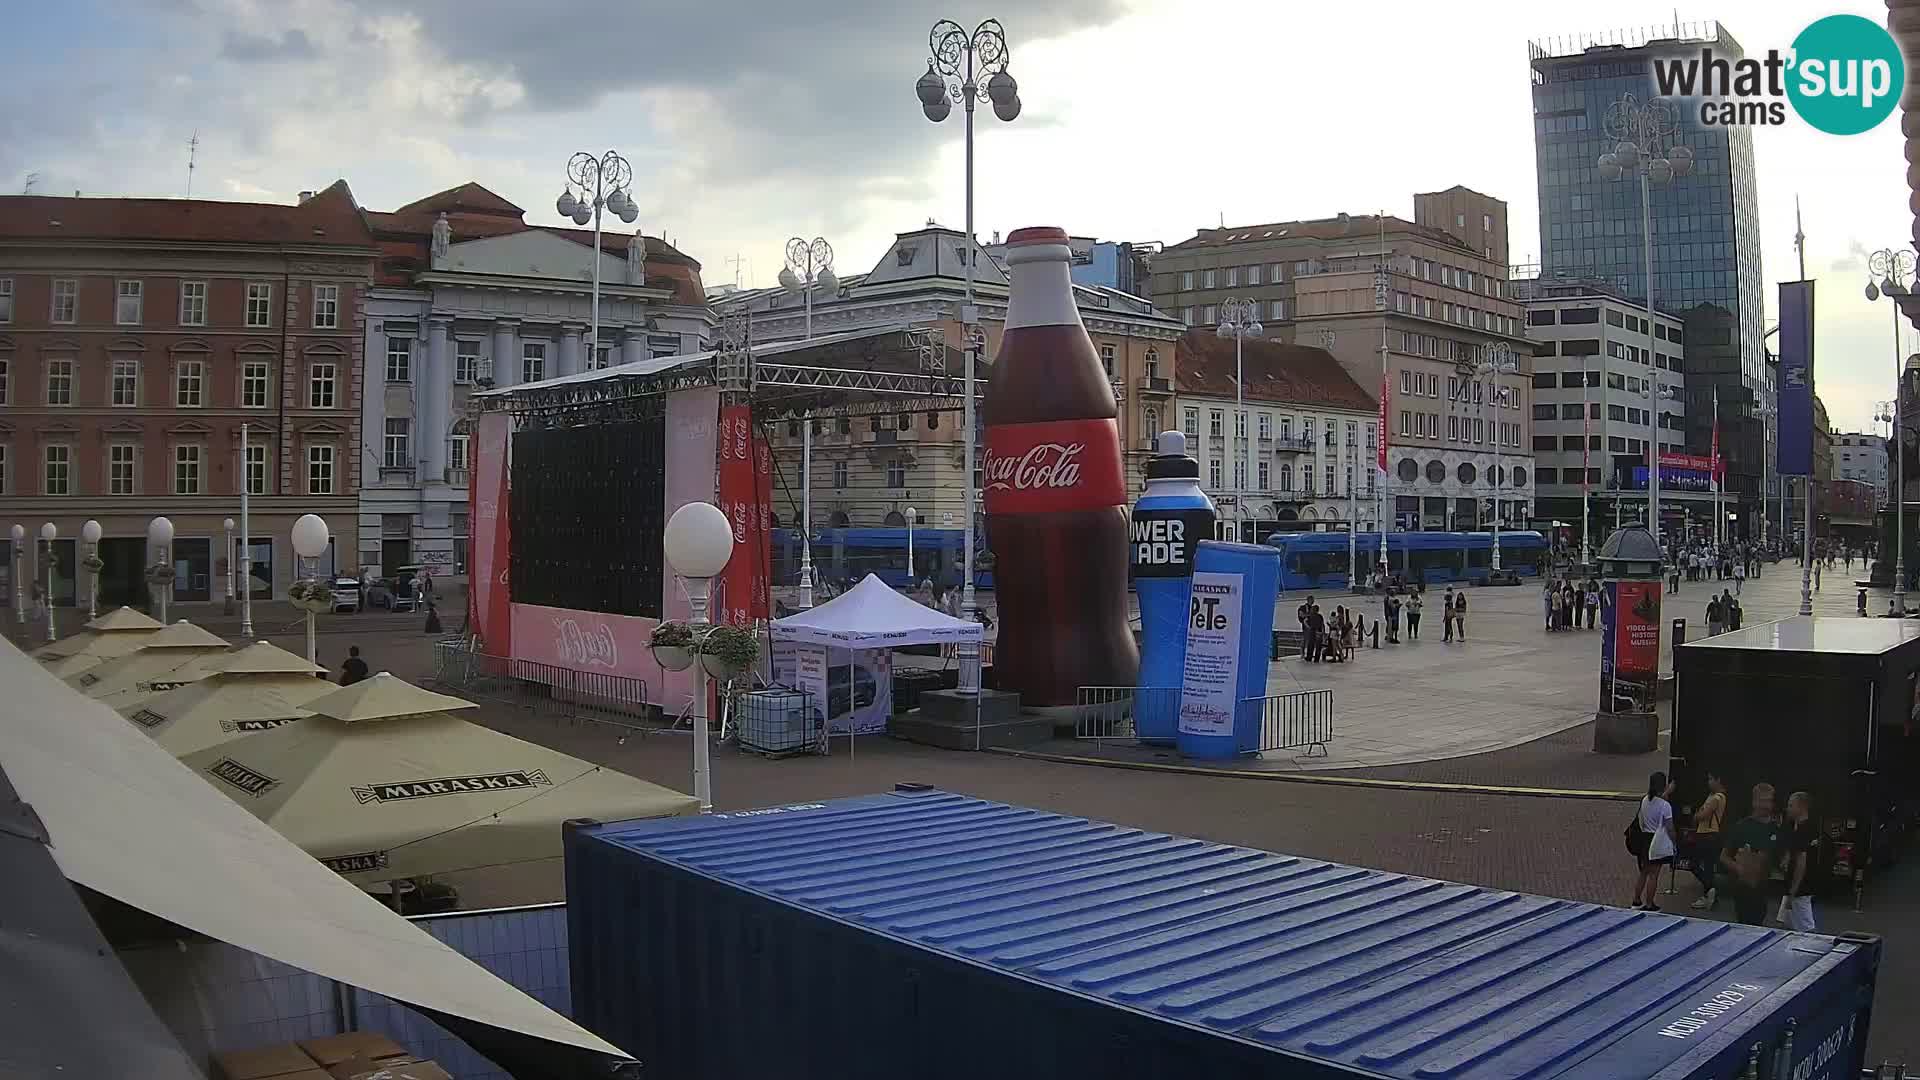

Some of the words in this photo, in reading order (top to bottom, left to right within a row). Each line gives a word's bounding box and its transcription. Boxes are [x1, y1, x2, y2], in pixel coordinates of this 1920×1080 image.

[1138, 542, 1185, 565] ADE
[1626, 624, 1646, 632] VIDEO
[384, 772, 525, 799] MARASKA
[1691, 989, 1745, 1018] 300629
